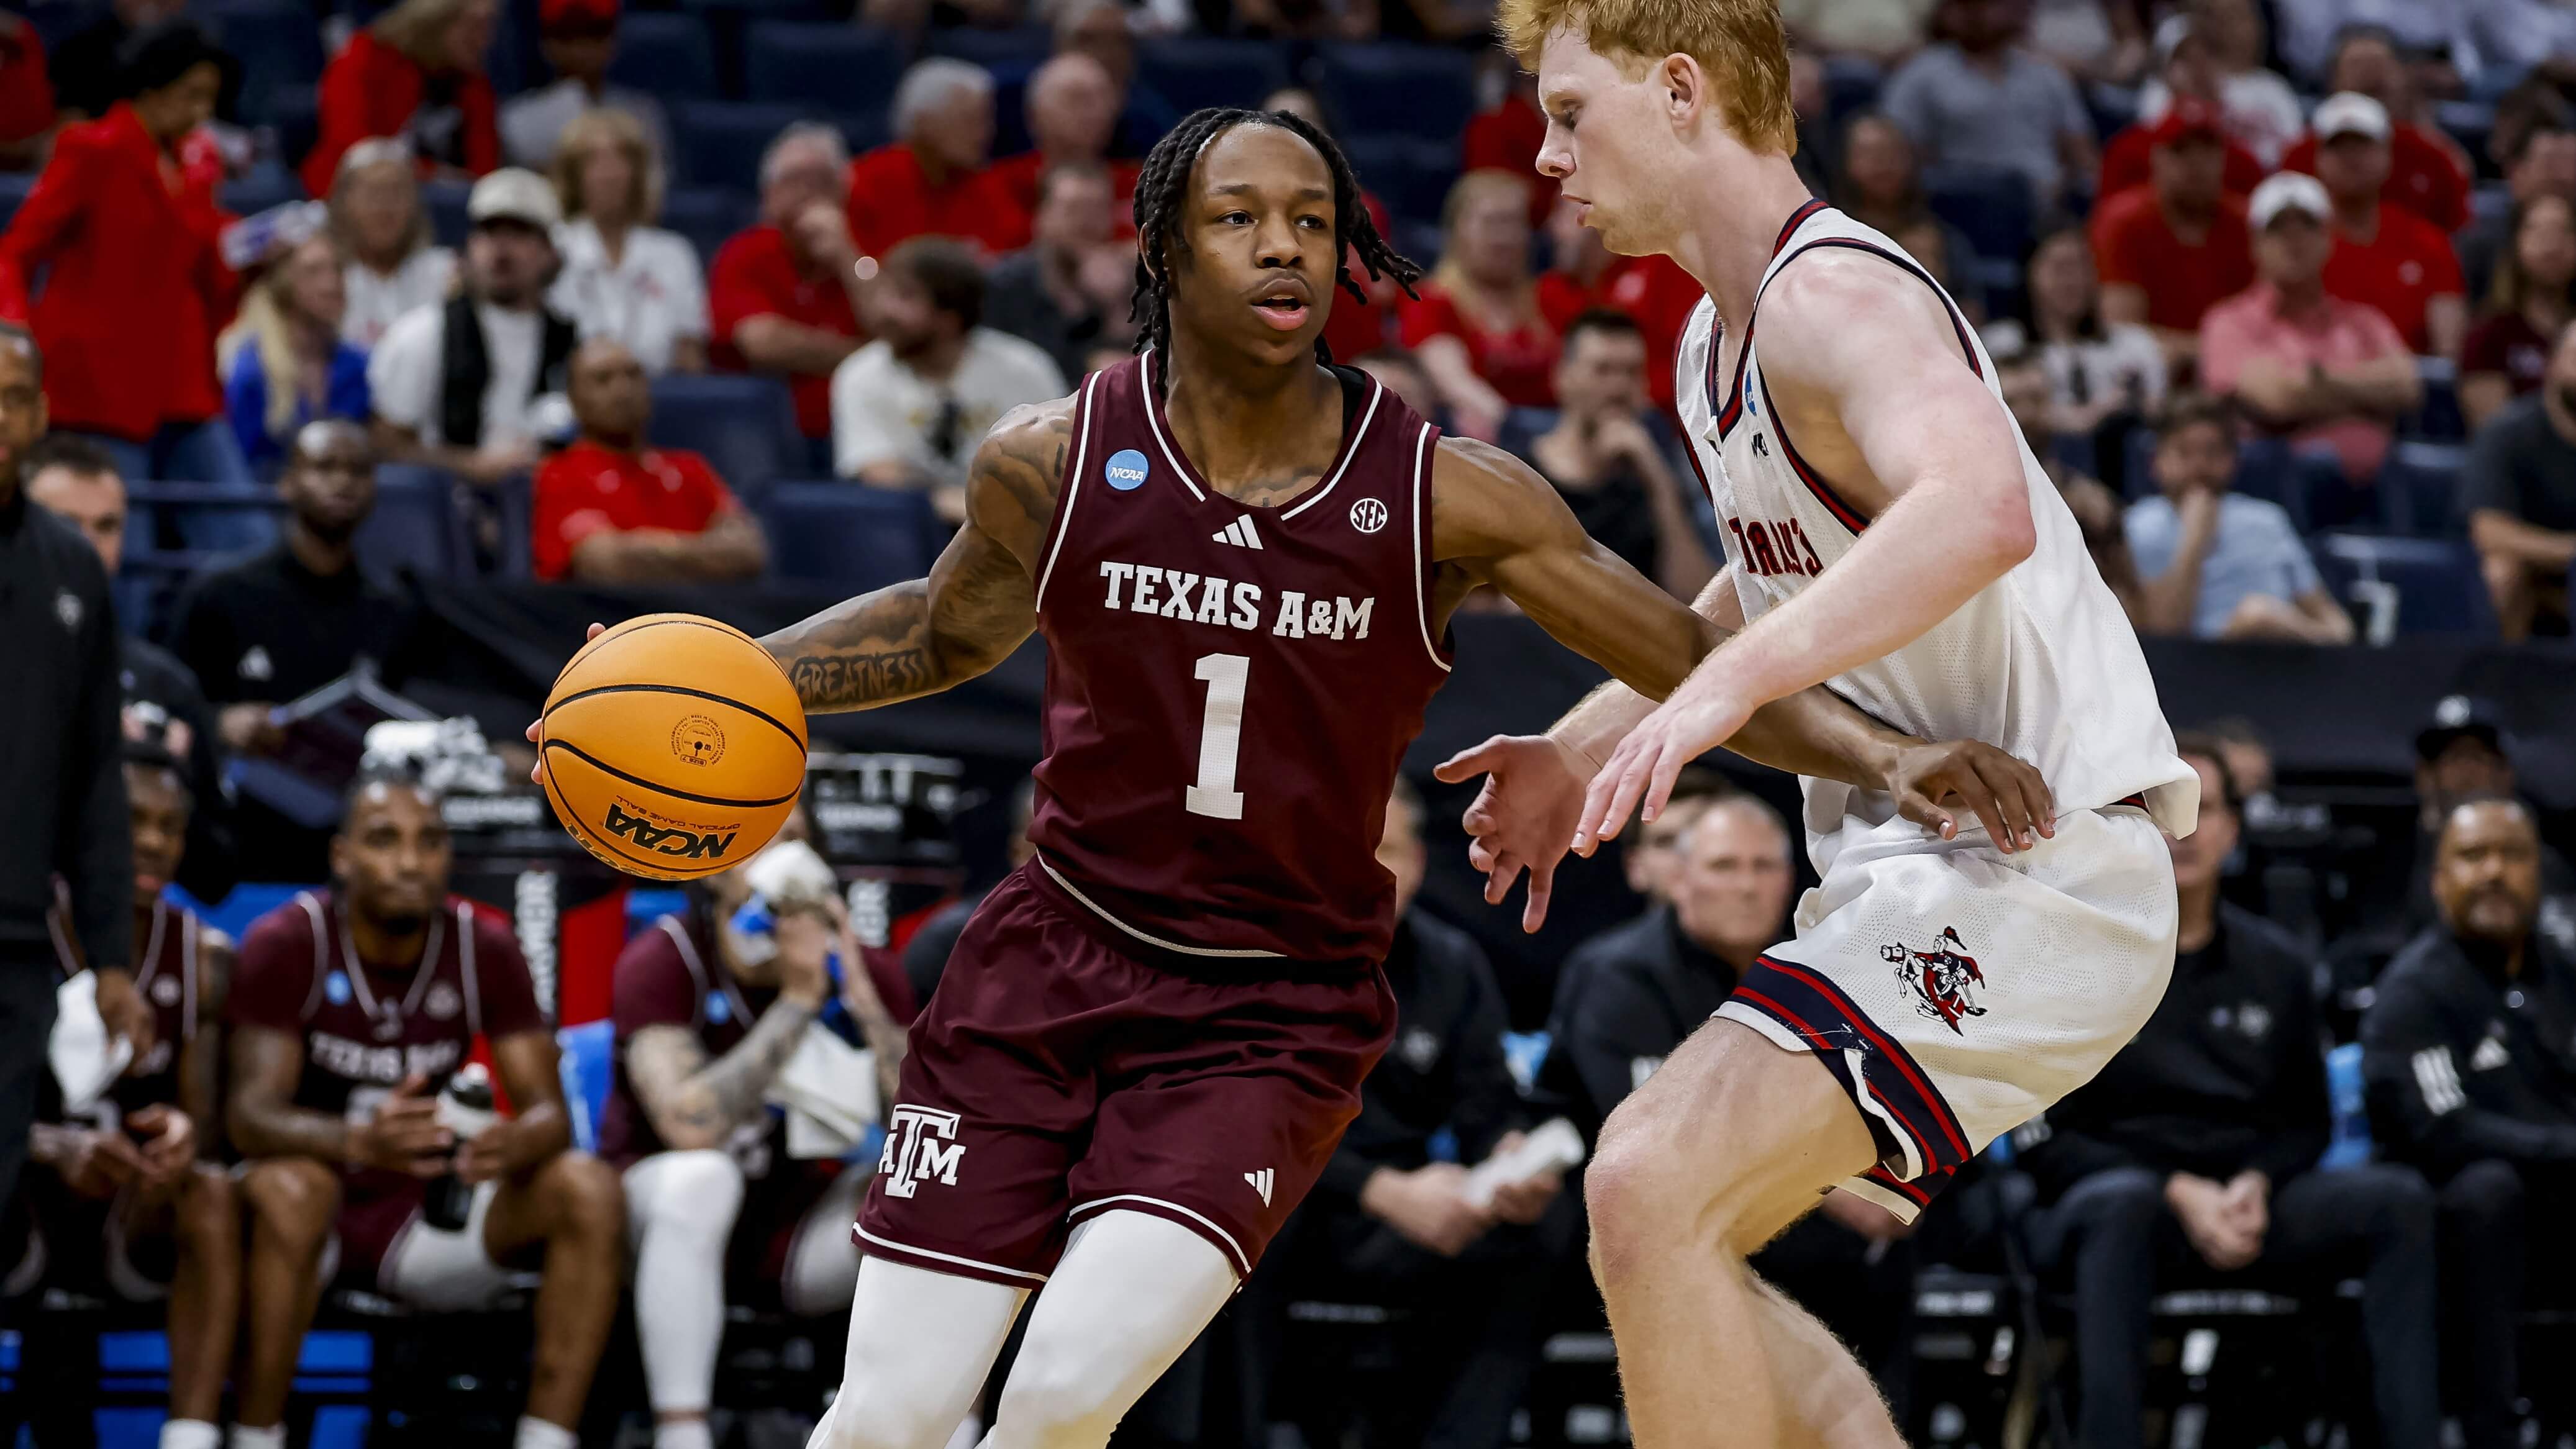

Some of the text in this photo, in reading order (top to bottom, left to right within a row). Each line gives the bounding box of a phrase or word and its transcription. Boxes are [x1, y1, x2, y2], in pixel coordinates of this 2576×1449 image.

[1109, 466, 1145, 482] NCAA
[1352, 503, 1387, 529] SEC
[1100, 561, 1375, 640] TEXAS A&M
[794, 653, 926, 704] GREATNESS
[1186, 653, 1250, 820] 1
[689, 757, 704, 765] SIZE
[603, 802, 737, 860] NCAA
[616, 795, 741, 831] OFFICIAL GAME BALL
